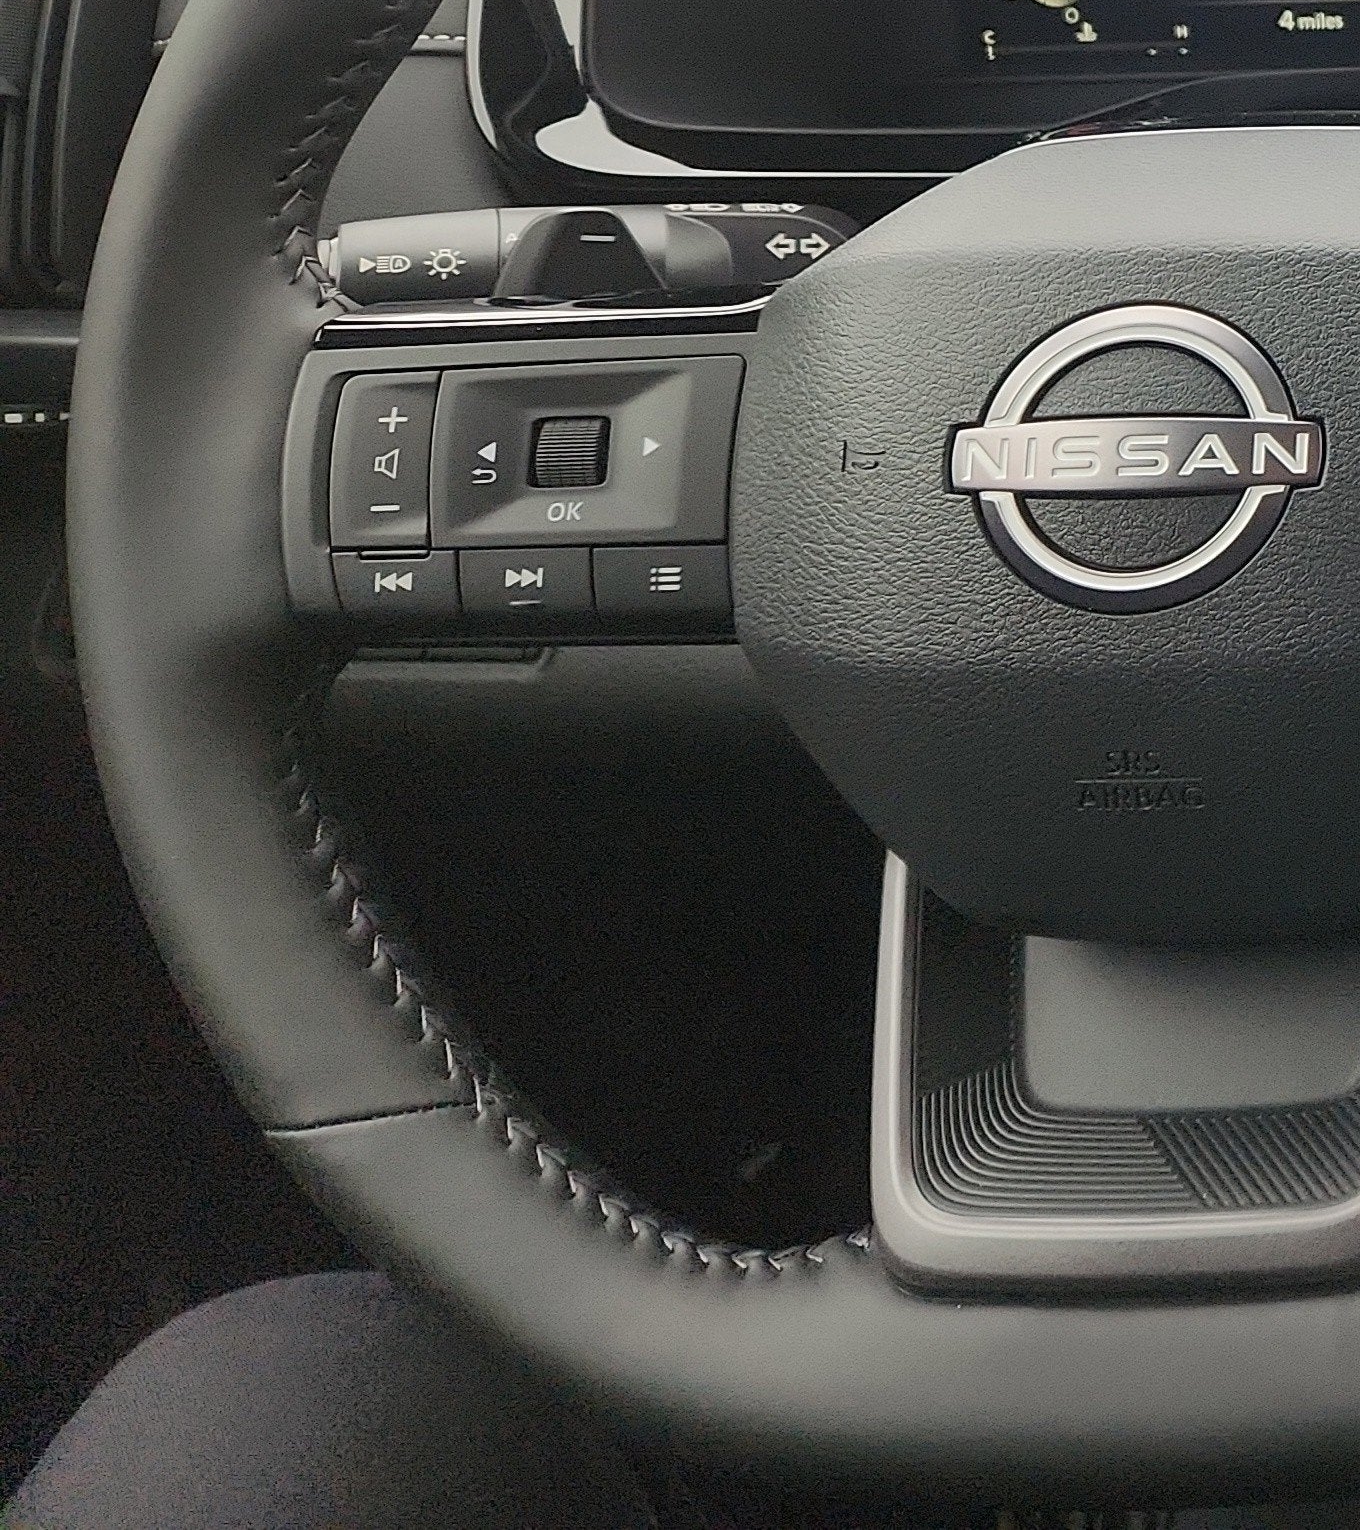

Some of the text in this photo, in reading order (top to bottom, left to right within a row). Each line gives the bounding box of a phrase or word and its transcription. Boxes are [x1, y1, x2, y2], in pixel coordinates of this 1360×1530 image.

[1064, 7, 1080, 25] 0
[1278, 11, 1344, 31] 4 miles
[962, 431, 1311, 483] NISSAN
[547, 502, 583, 521] OK
